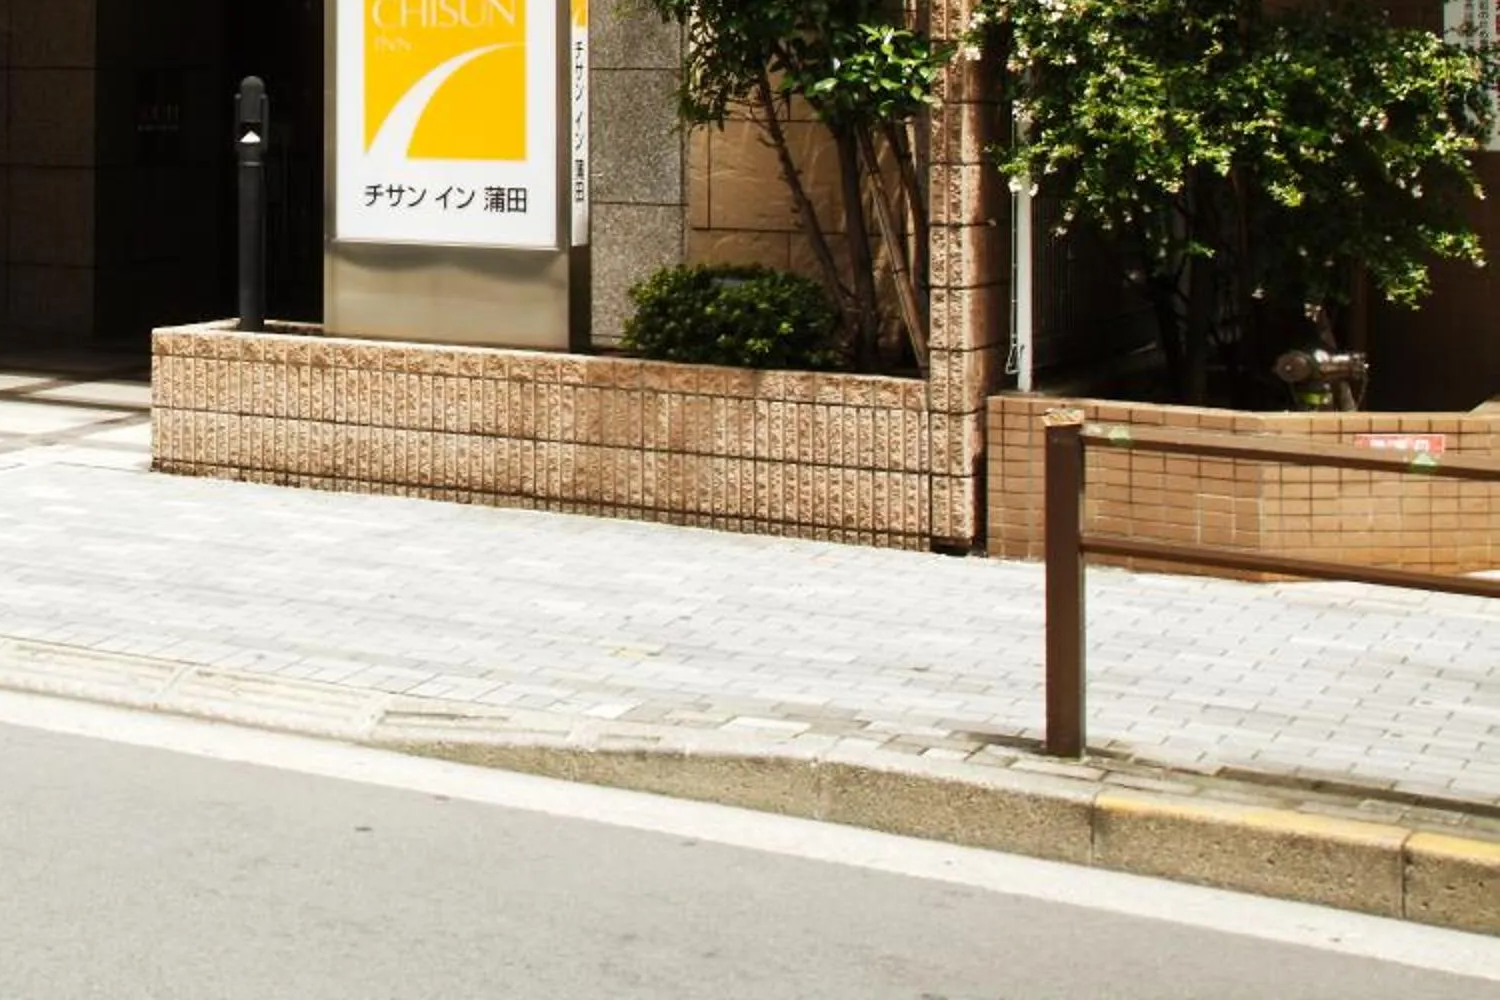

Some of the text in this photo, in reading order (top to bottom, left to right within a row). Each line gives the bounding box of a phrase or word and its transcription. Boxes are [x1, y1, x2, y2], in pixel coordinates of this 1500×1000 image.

[364, 184, 527, 213] チサン イン 蒲田
